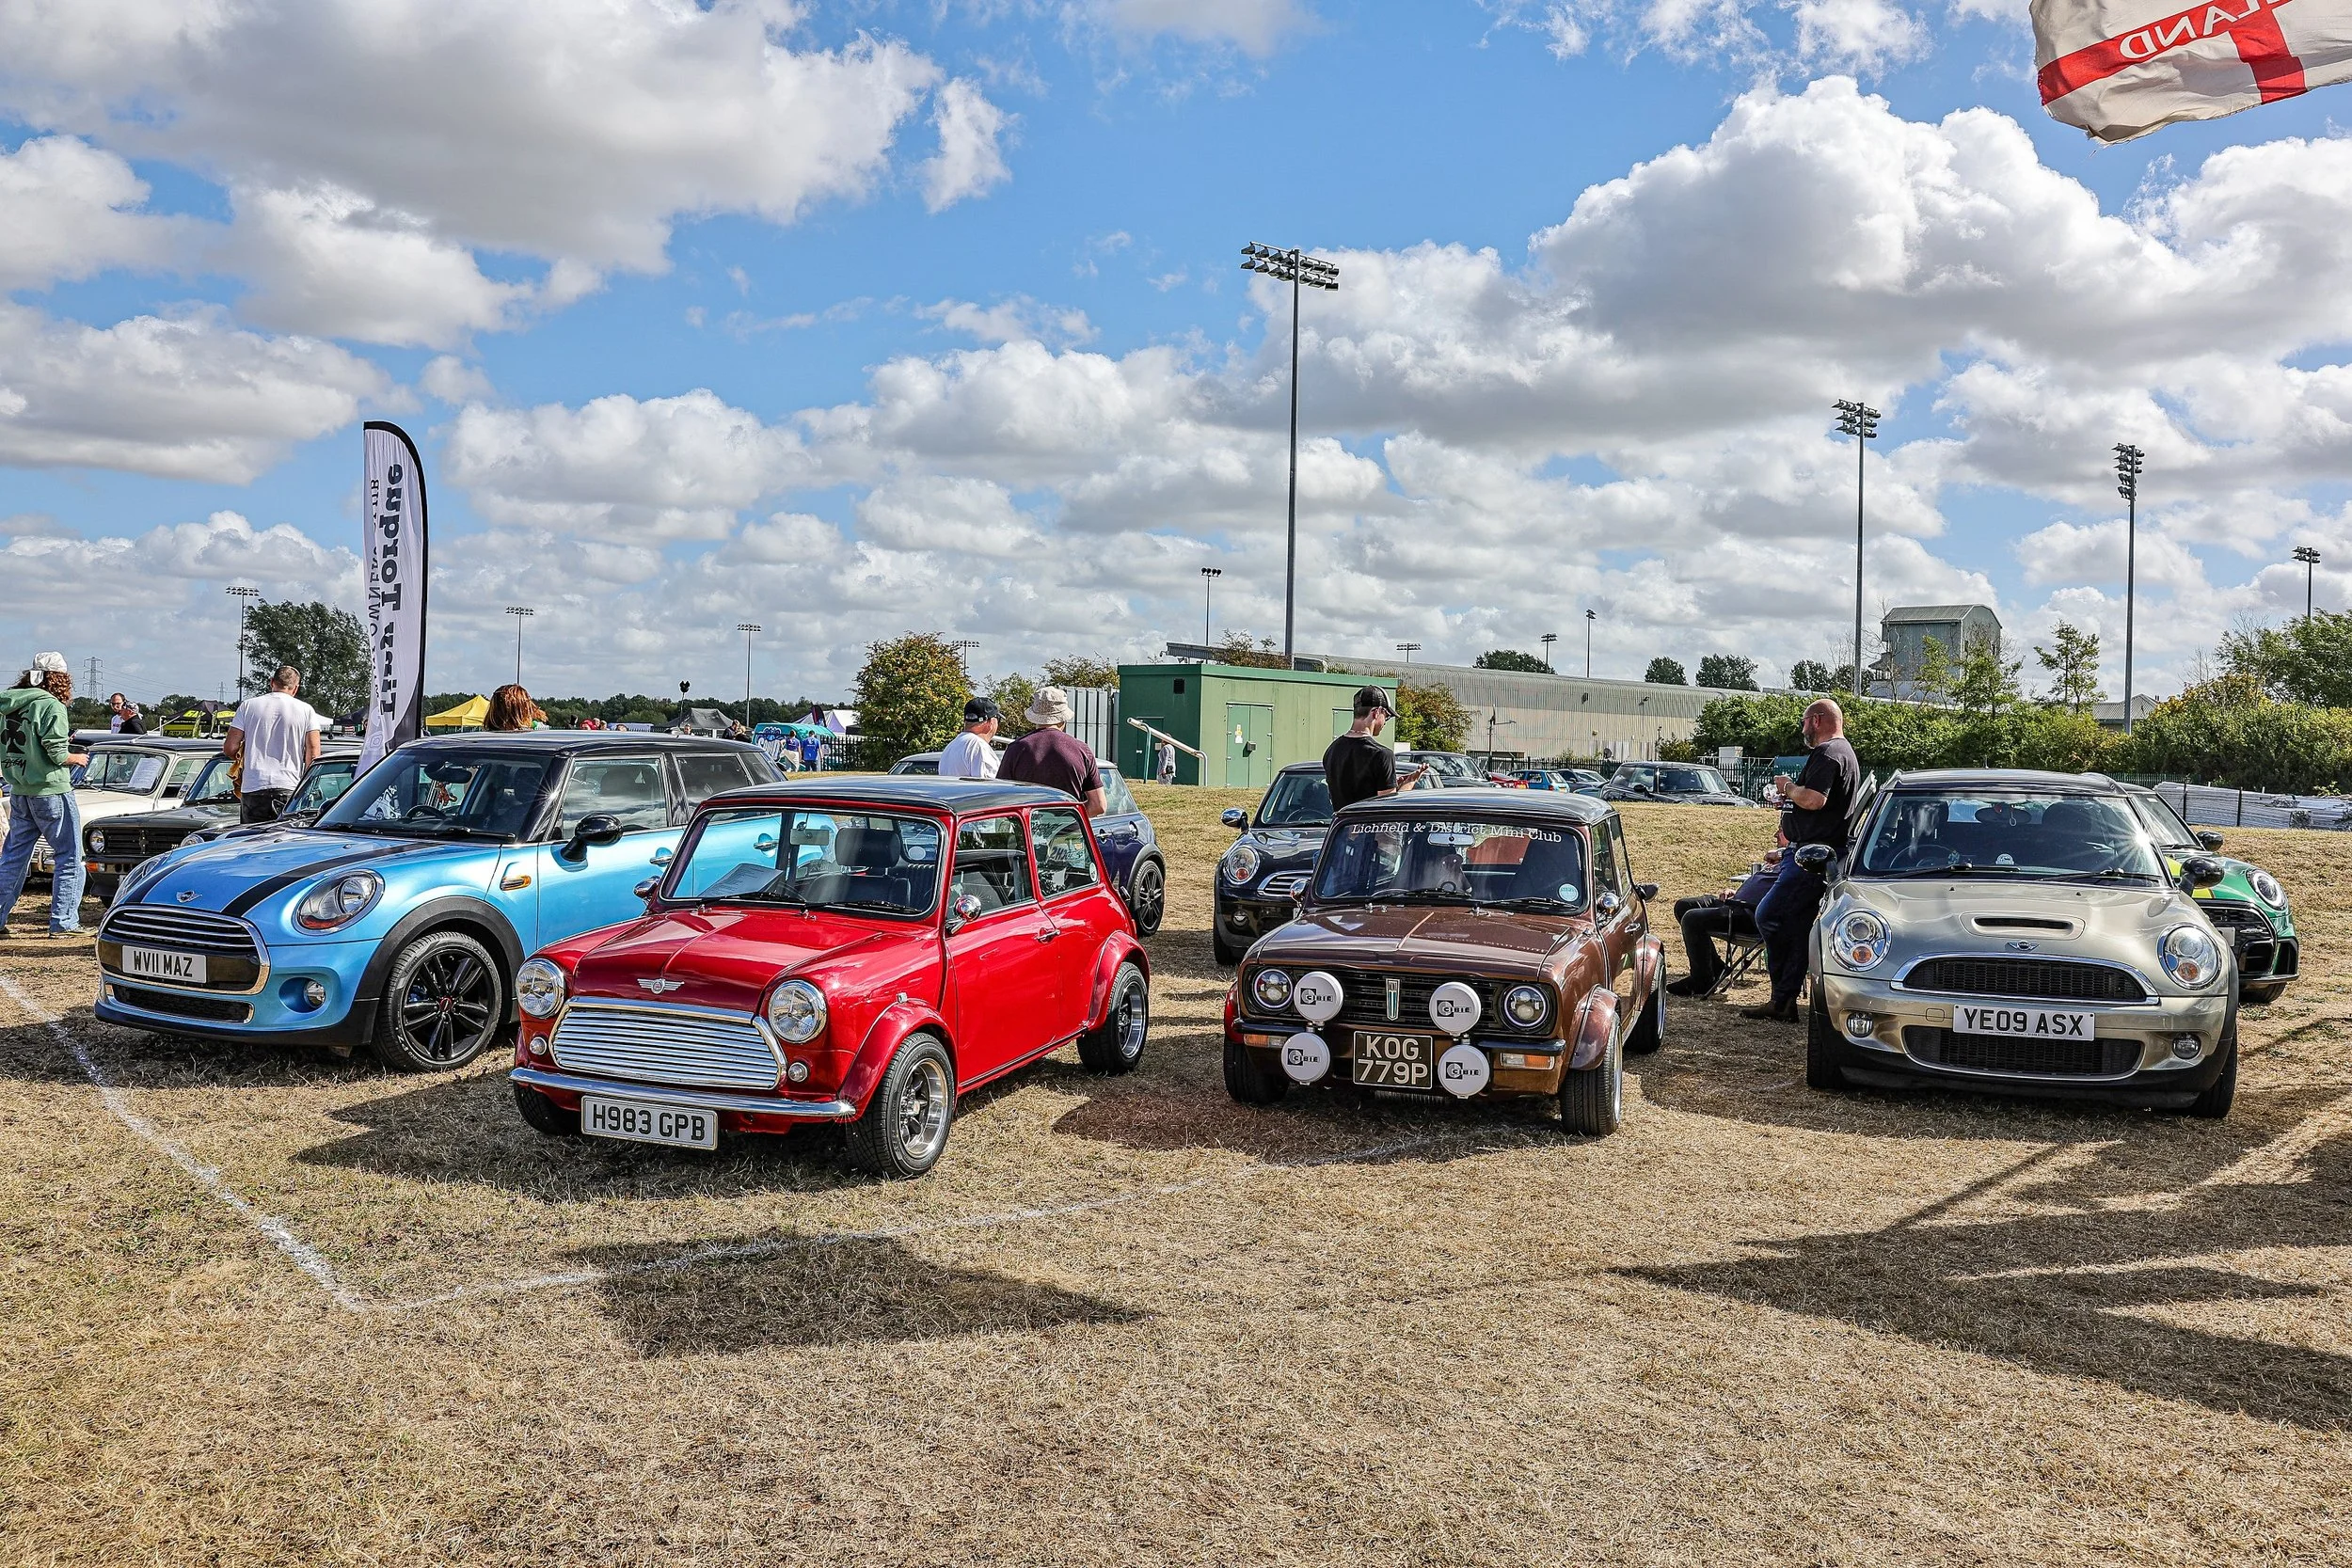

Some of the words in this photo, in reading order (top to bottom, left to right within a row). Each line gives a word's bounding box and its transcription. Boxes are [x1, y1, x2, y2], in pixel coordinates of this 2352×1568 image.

[1351, 822, 1409, 834] Lichfield
[1413, 822, 1426, 833] &
[1429, 823, 1486, 834] District
[1489, 825, 1525, 839] Mini
[1528, 828, 1562, 843] Club
[163, 954, 193, 978] MAZ
[1963, 1007, 2027, 1032] YE09
[2035, 1012, 2084, 1037] ASX
[1366, 1035, 1420, 1060] KOG
[1358, 1059, 1428, 1085] 779P
[593, 1103, 652, 1135] H983
[659, 1112, 706, 1141] GPB
